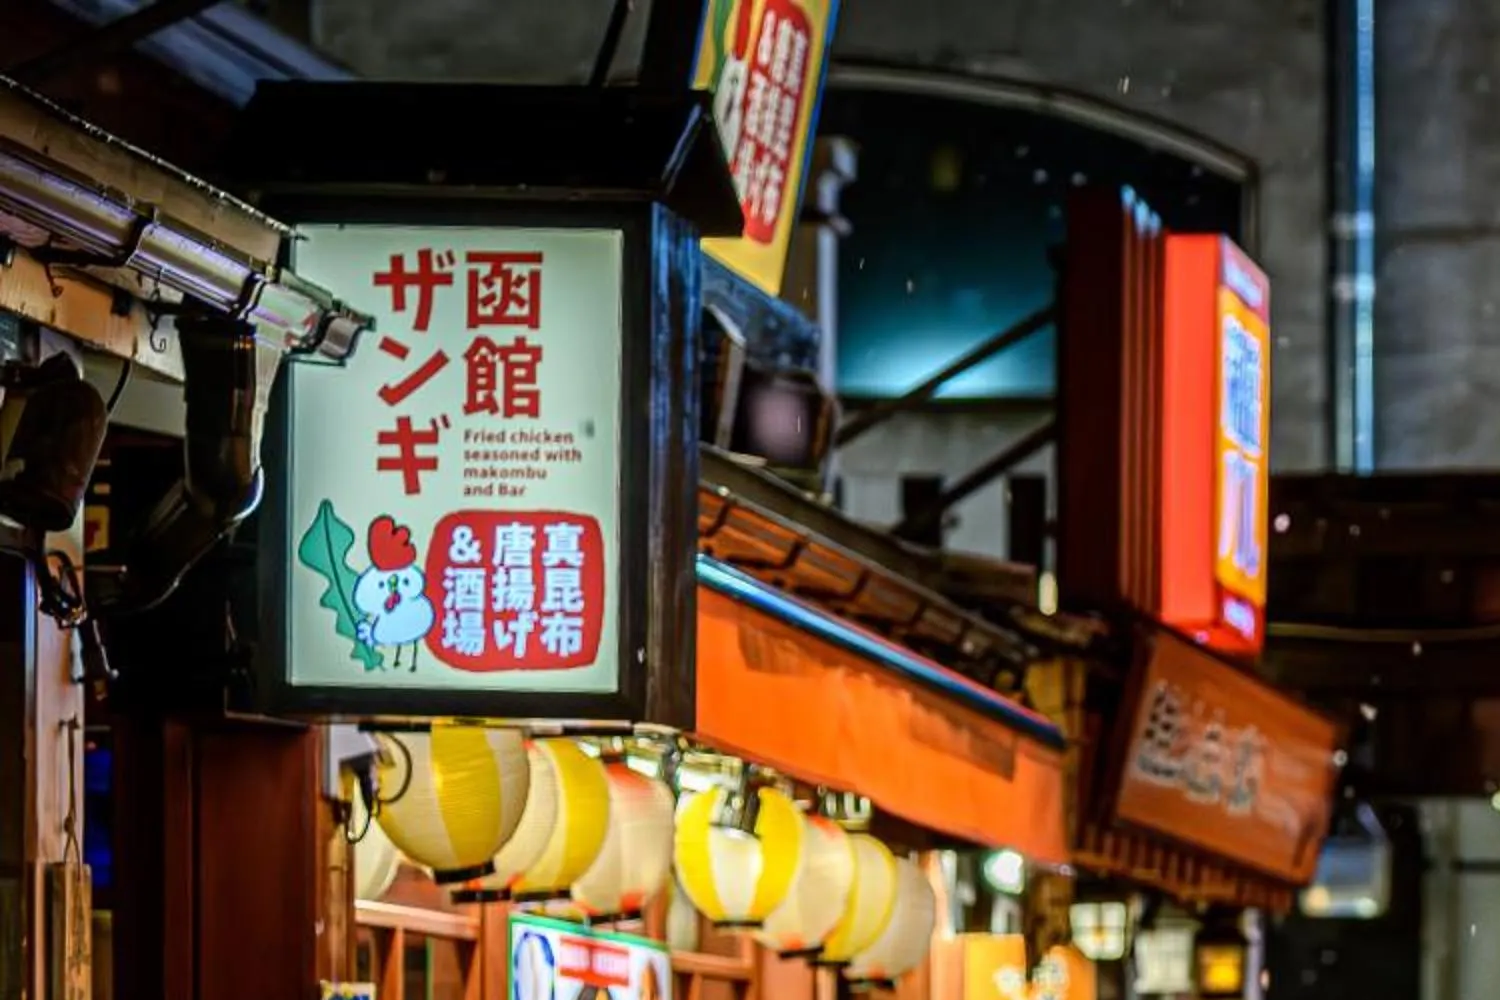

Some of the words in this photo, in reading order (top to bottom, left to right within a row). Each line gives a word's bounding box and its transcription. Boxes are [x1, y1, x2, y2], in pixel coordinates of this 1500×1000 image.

[373, 248, 455, 496] ザンギ
[463, 250, 544, 419] 函館
[463, 429, 506, 443] Fried
[509, 429, 575, 443] chicken
[463, 447, 541, 462] seasoned
[544, 448, 583, 463] with
[463, 466, 547, 479] makombu
[463, 484, 493, 497] and
[498, 484, 526, 497] Bar
[441, 525, 486, 656] &酒場
[491, 522, 539, 658] 唐揚げ
[539, 522, 586, 657] 真昆布
